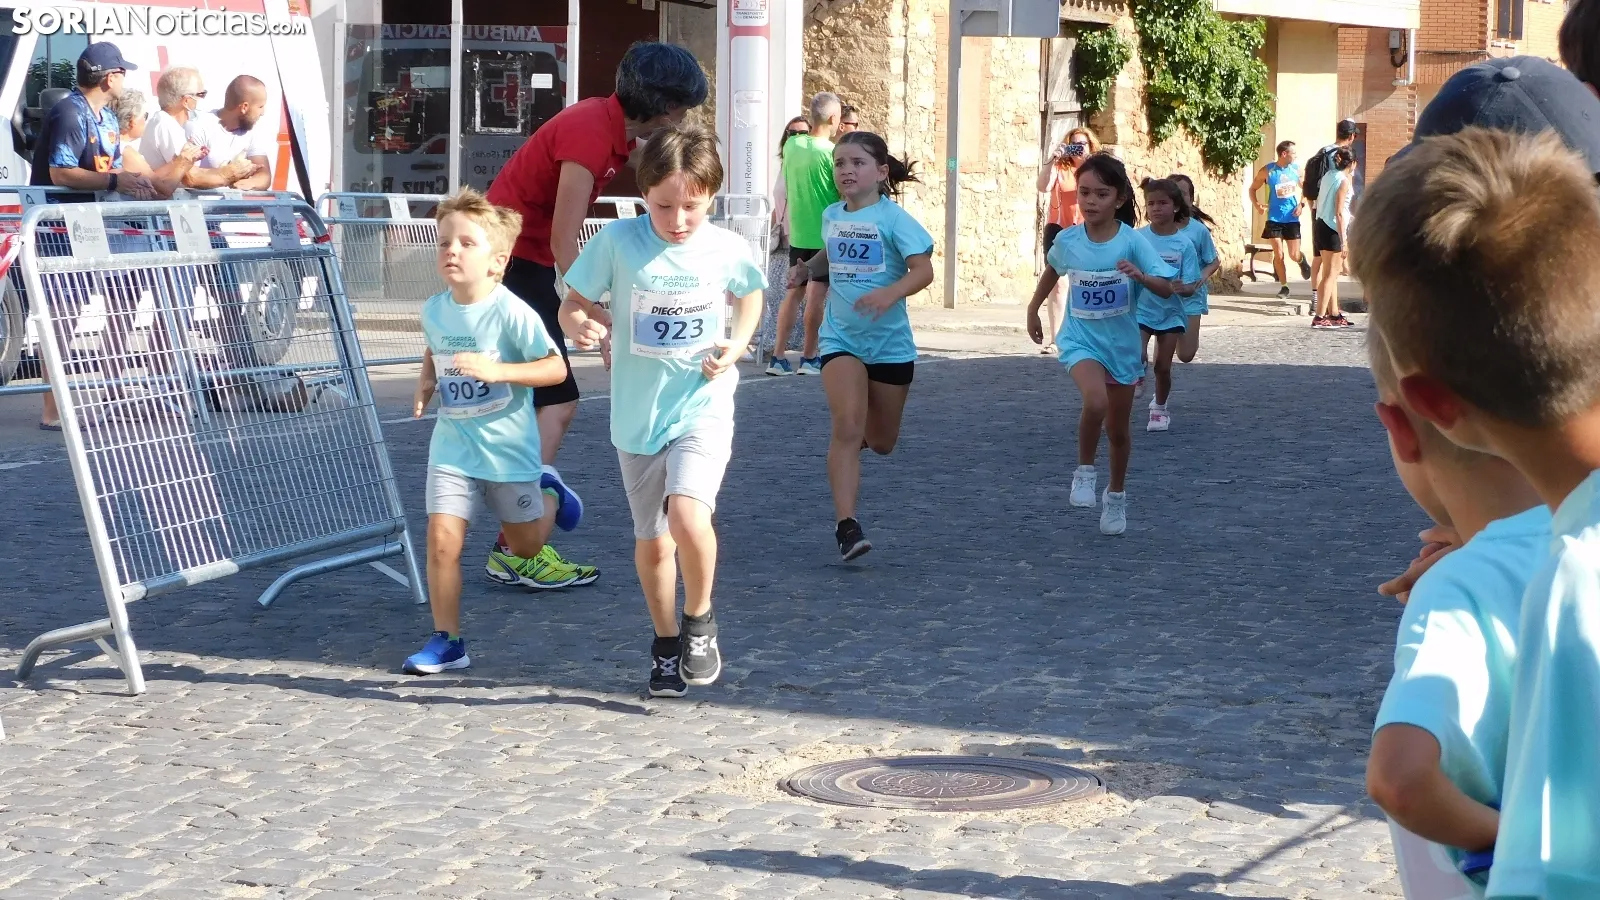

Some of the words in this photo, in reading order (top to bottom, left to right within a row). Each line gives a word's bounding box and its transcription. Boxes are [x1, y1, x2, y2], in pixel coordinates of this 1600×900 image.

[744, 141, 753, 179] Redonda
[838, 230, 856, 239] DIEGO
[838, 242, 870, 260] 962
[1080, 279, 1099, 288] DIEGO
[1081, 289, 1116, 306] 950
[651, 305, 683, 316] DIEGO
[653, 318, 704, 341] 923
[448, 380, 490, 401] 903
